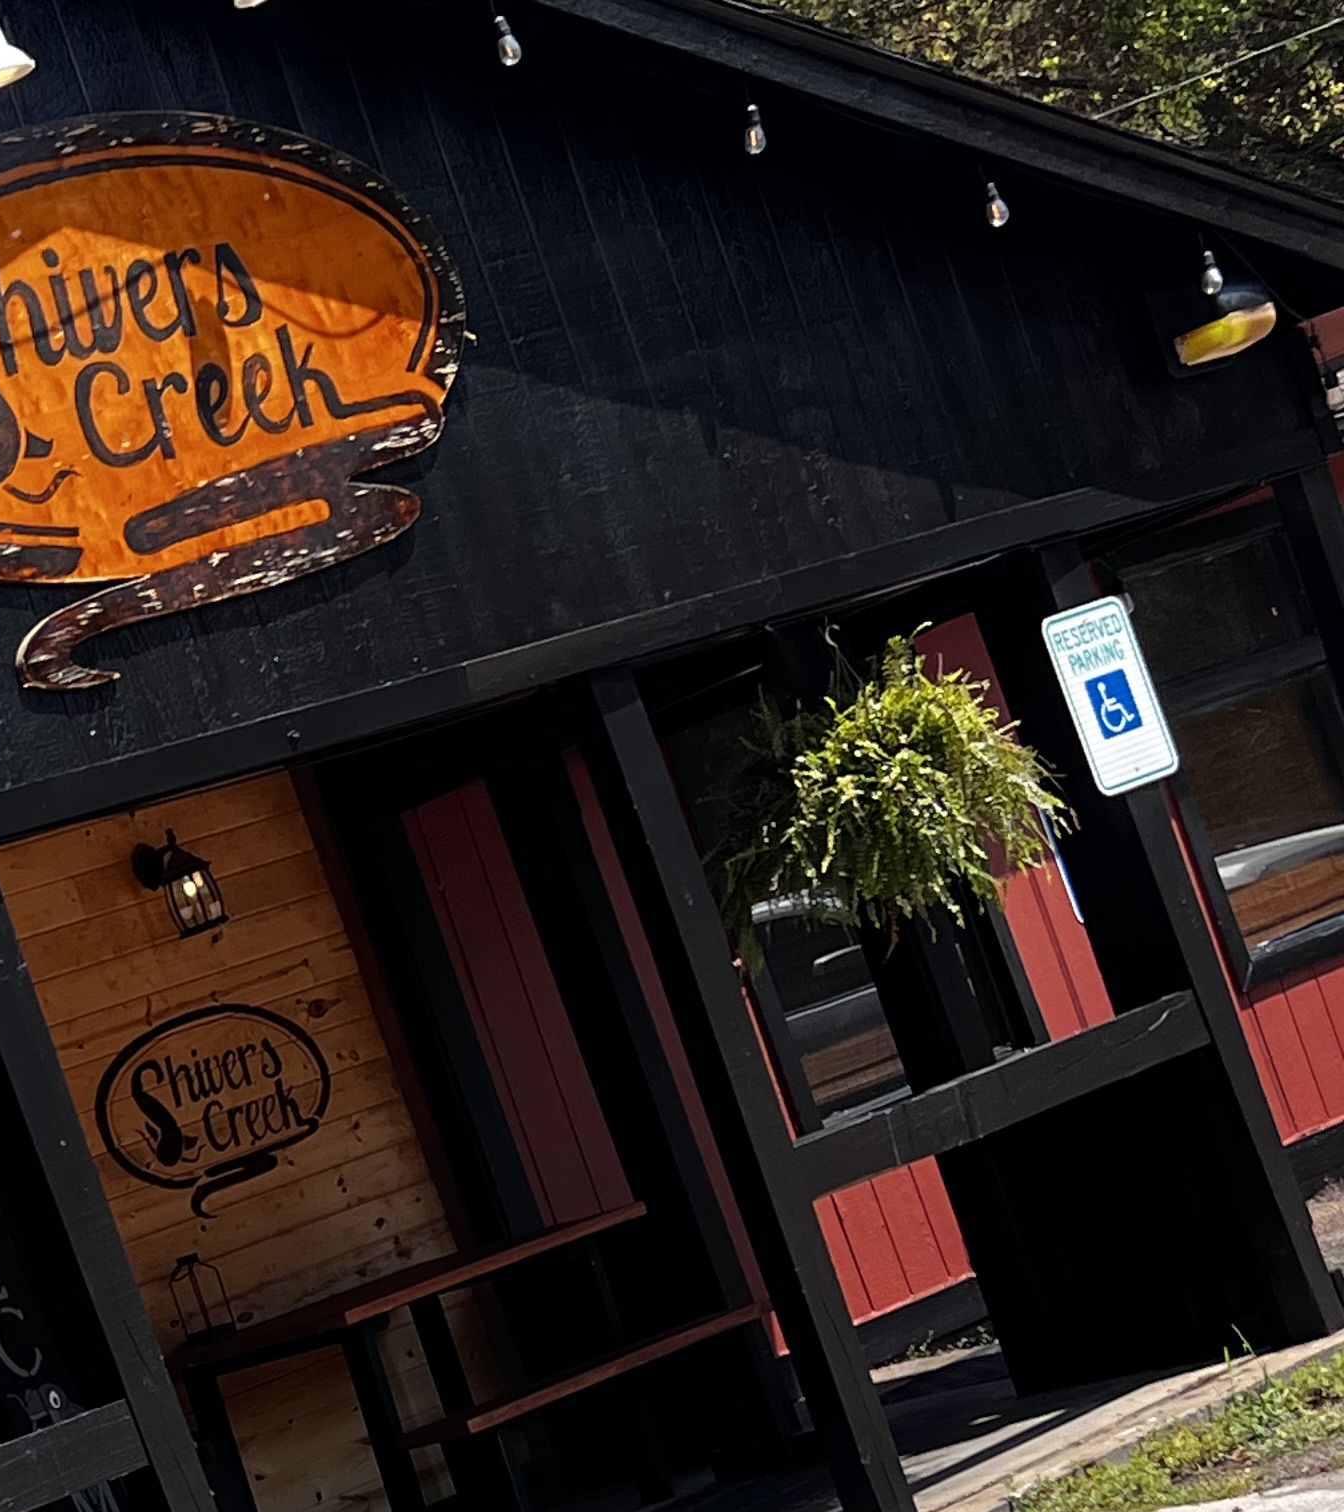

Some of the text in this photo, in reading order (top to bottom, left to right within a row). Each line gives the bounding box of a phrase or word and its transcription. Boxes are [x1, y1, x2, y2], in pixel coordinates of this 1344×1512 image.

[73, 323, 357, 467] Creek
[1052, 613, 1123, 653] RESERVED
[1067, 638, 1125, 676] PARKING
[130, 1037, 283, 1167] Shivers
[202, 1077, 306, 1152] Creek
